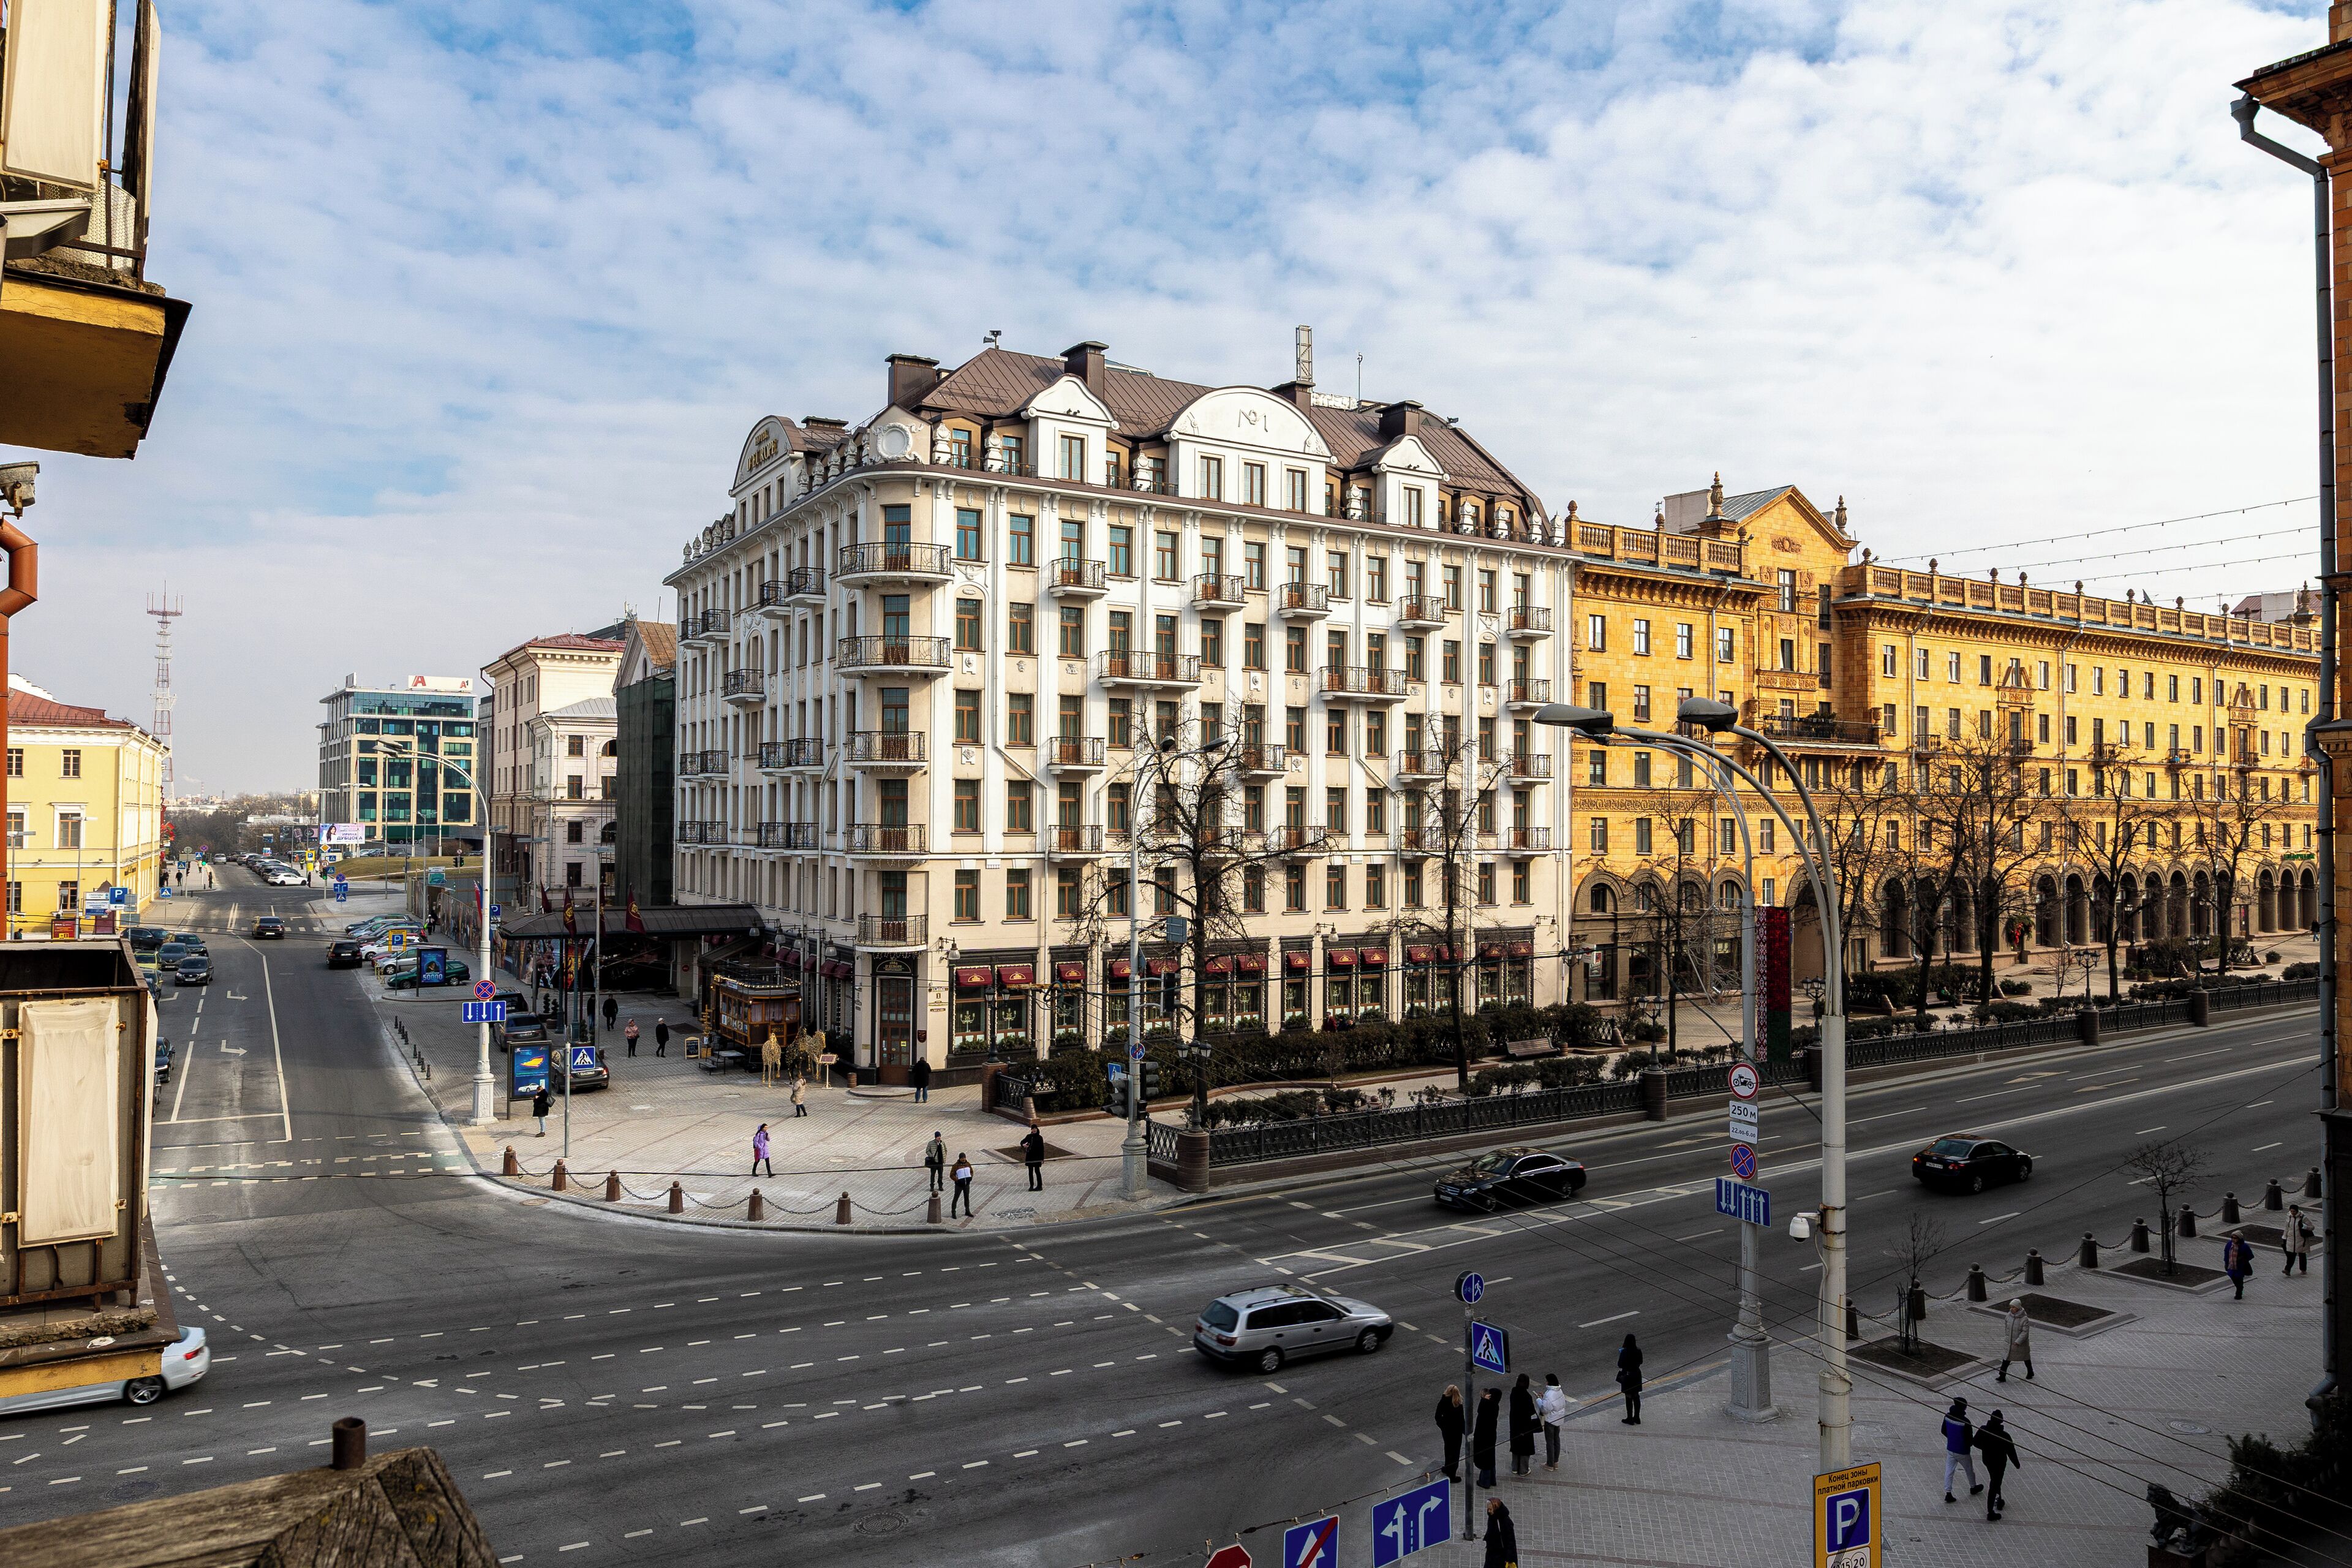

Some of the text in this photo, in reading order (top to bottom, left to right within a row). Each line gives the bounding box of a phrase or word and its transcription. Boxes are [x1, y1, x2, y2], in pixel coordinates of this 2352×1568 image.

[755, 430, 769, 447] HOTEL
[747, 439, 778, 472] D'EUROPE
[460, 680, 469, 688] A1
[394, 935, 401, 944] P
[1732, 1105, 1748, 1117] 250
[1732, 1127, 1756, 1138] 22.00-6.00
[1828, 1469, 1868, 1483] Конец зоны
[1817, 1476, 1879, 1495] платной парковки
[1836, 1498, 1860, 1545] P
[1853, 1557, 1865, 1568] 20
